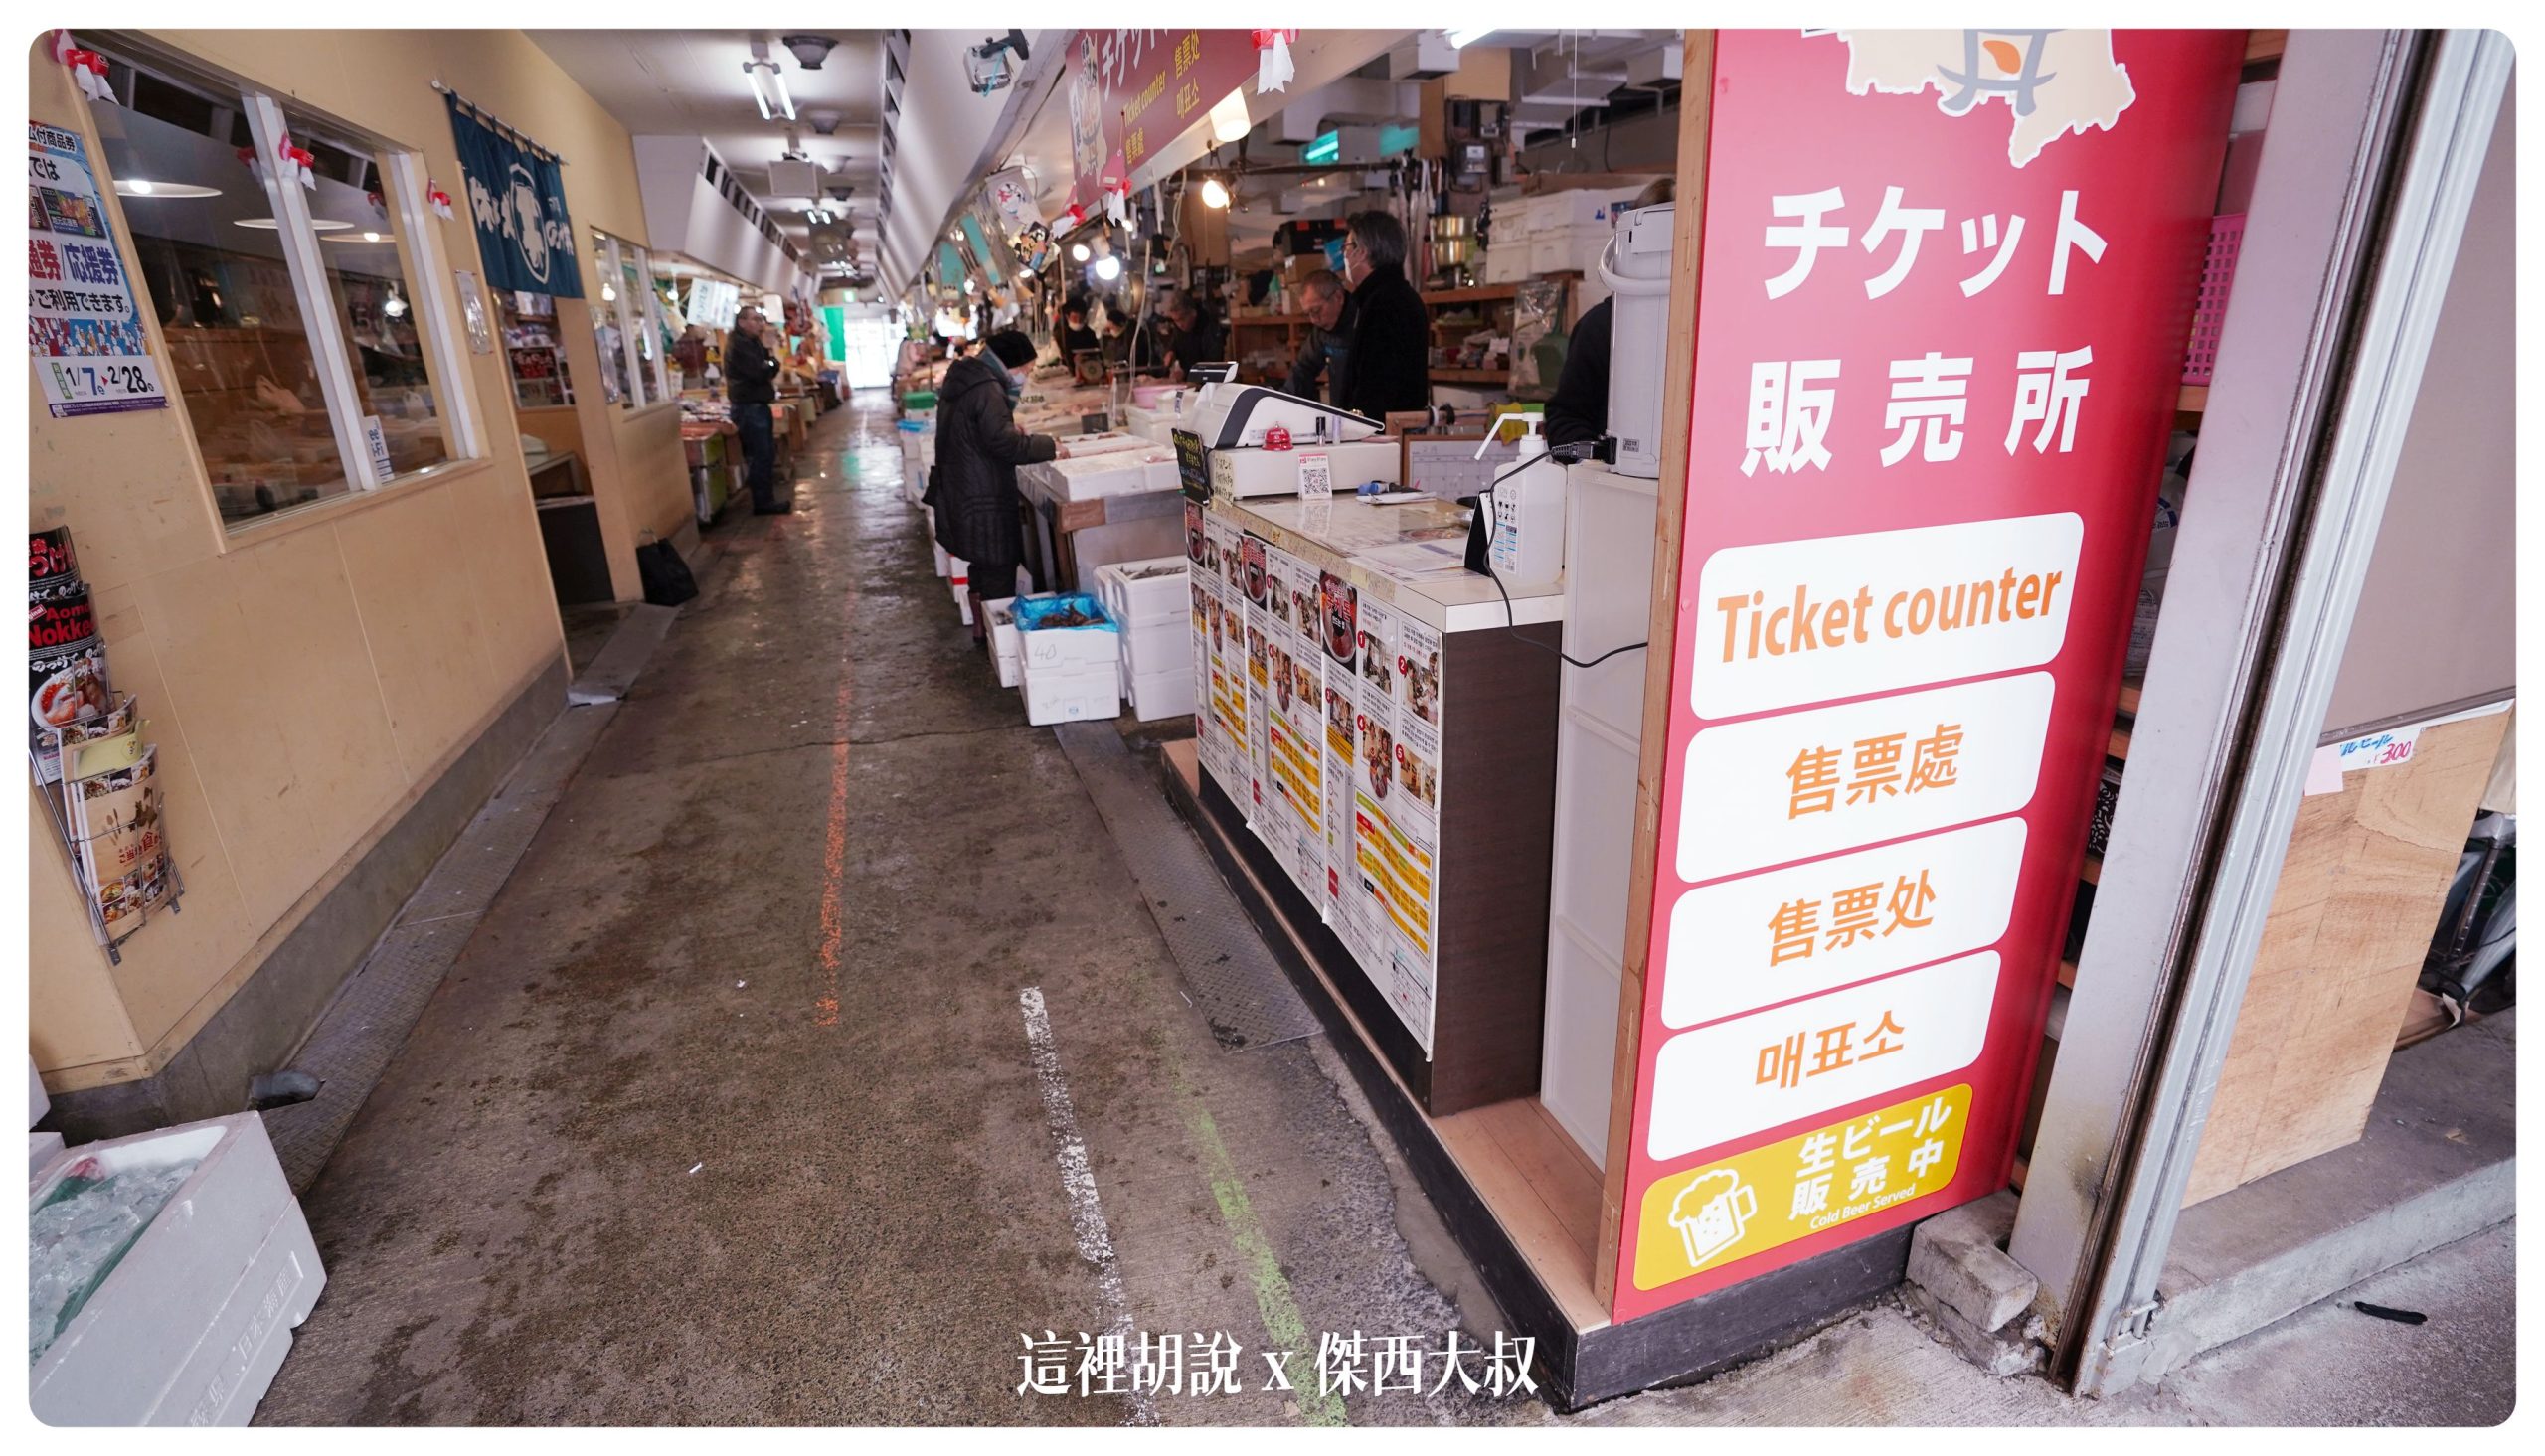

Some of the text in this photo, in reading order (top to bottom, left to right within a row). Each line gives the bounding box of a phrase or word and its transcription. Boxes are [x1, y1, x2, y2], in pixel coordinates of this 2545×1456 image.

[1123, 90, 1141, 127] Ticket
[1142, 70, 1166, 111] counter
[1176, 77, 1200, 119] 매표소
[1764, 185, 2108, 300] チケット
[1740, 345, 2093, 477] 販売所
[1717, 584, 1873, 663] Ticket
[1884, 566, 2062, 639] counter
[1785, 723, 1964, 820] 售票處
[1767, 868, 1937, 968] 售票处
[1755, 1010, 1905, 1089] 매표소
[1788, 1137, 1945, 1220] 販売中
[1795, 1096, 1953, 1178] 生ビール
[1809, 1183, 1916, 1230] Cold Beer Served
